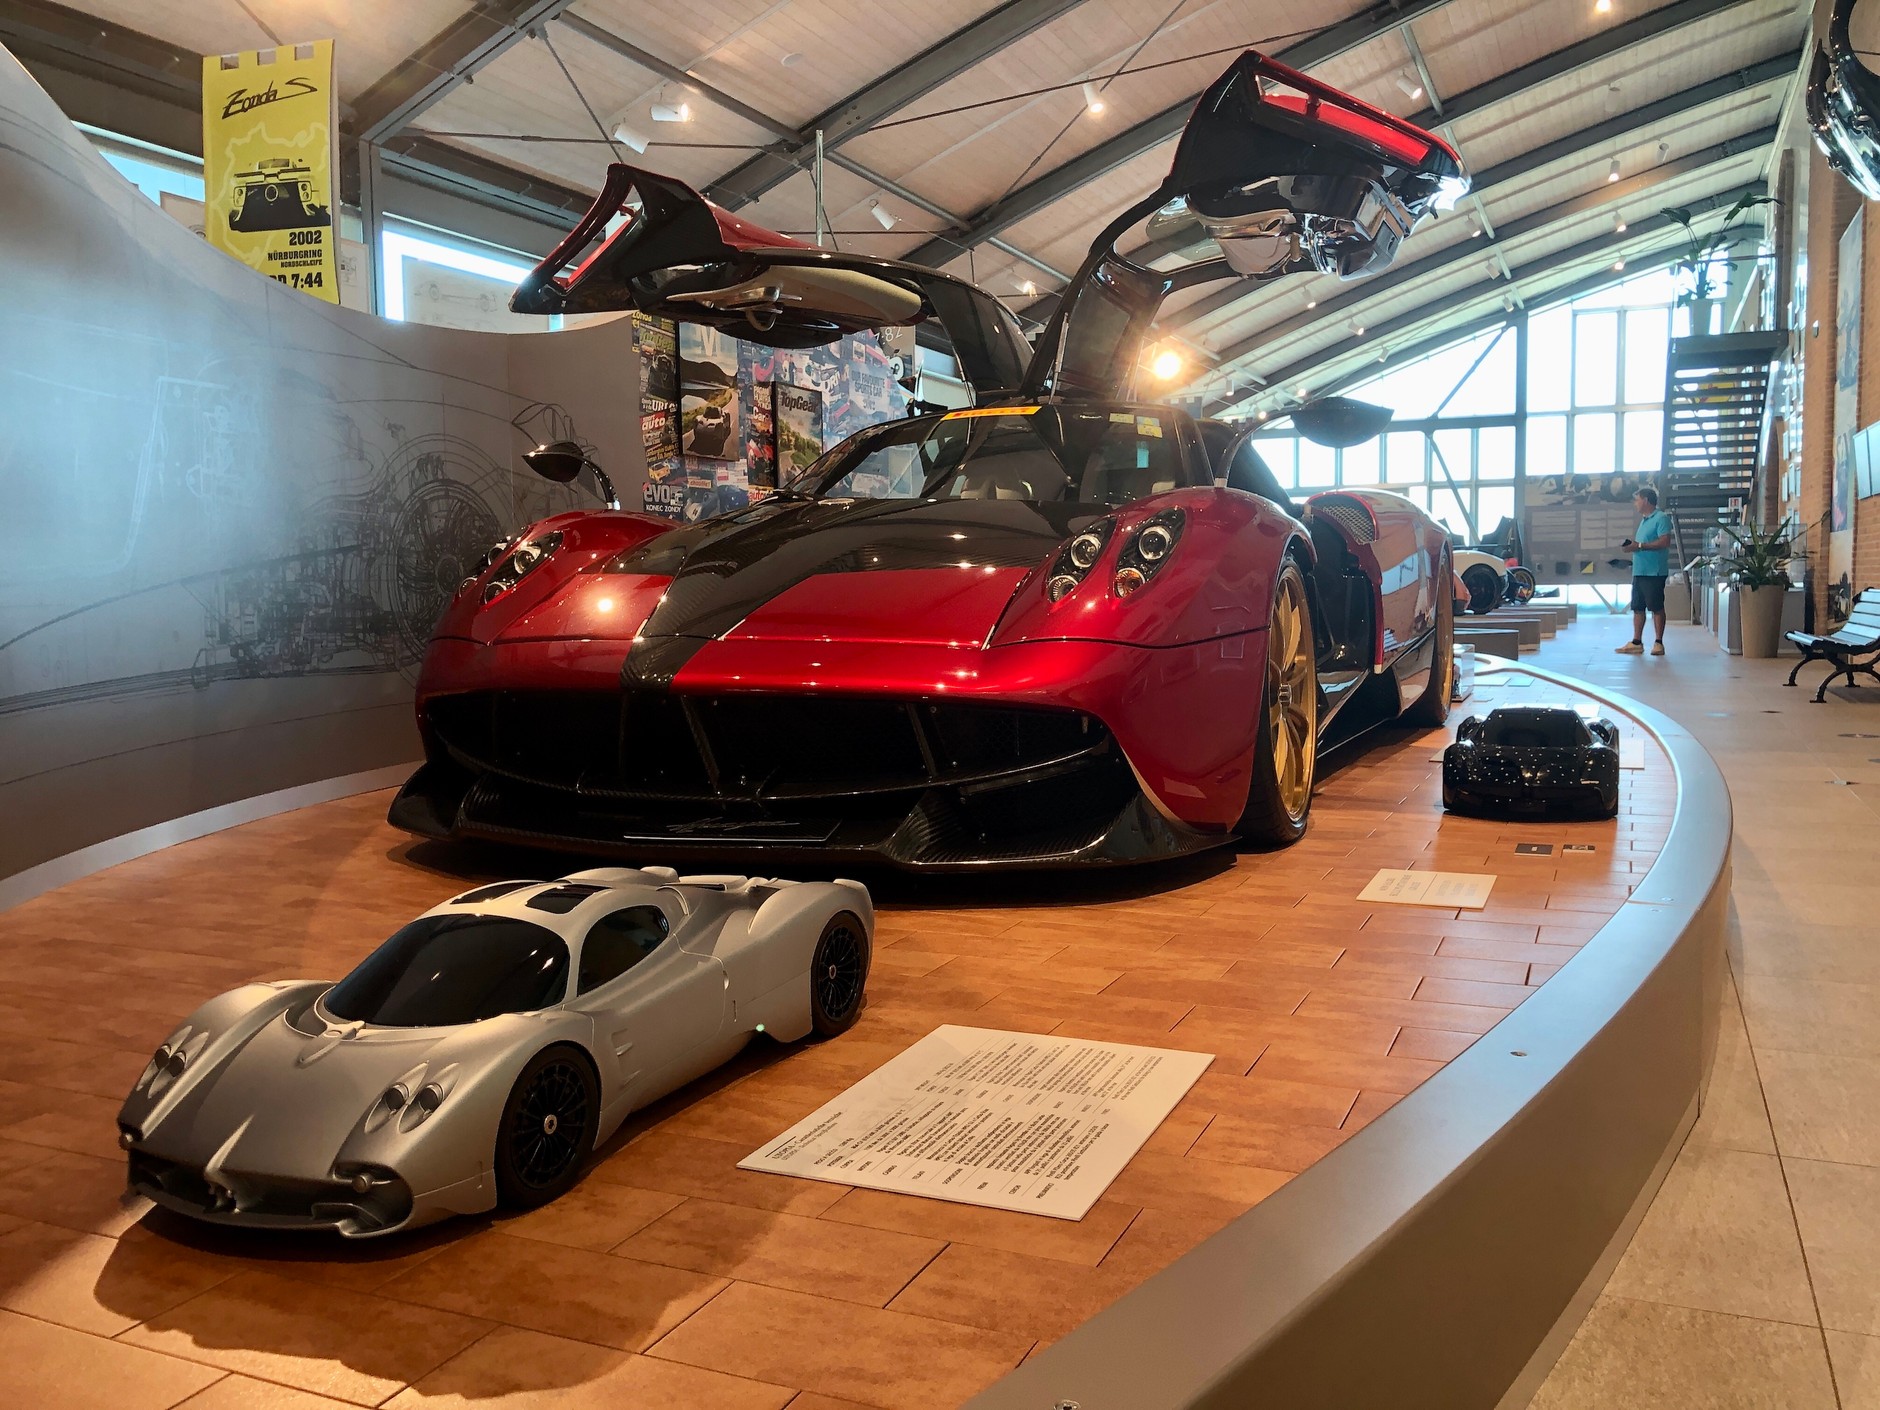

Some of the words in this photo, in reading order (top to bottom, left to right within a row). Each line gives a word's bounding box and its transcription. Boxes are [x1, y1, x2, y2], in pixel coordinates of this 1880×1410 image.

[222, 80, 278, 120] Zonda
[278, 77, 318, 98] S
[288, 230, 322, 246] 2002
[267, 248, 322, 262] NÜRBURGRING
[280, 259, 322, 268] NORDSCHLEIFE
[291, 272, 323, 289] 7:44
[780, 391, 818, 413] TopGear
[642, 418, 666, 431] auto
[644, 484, 670, 504] evo
